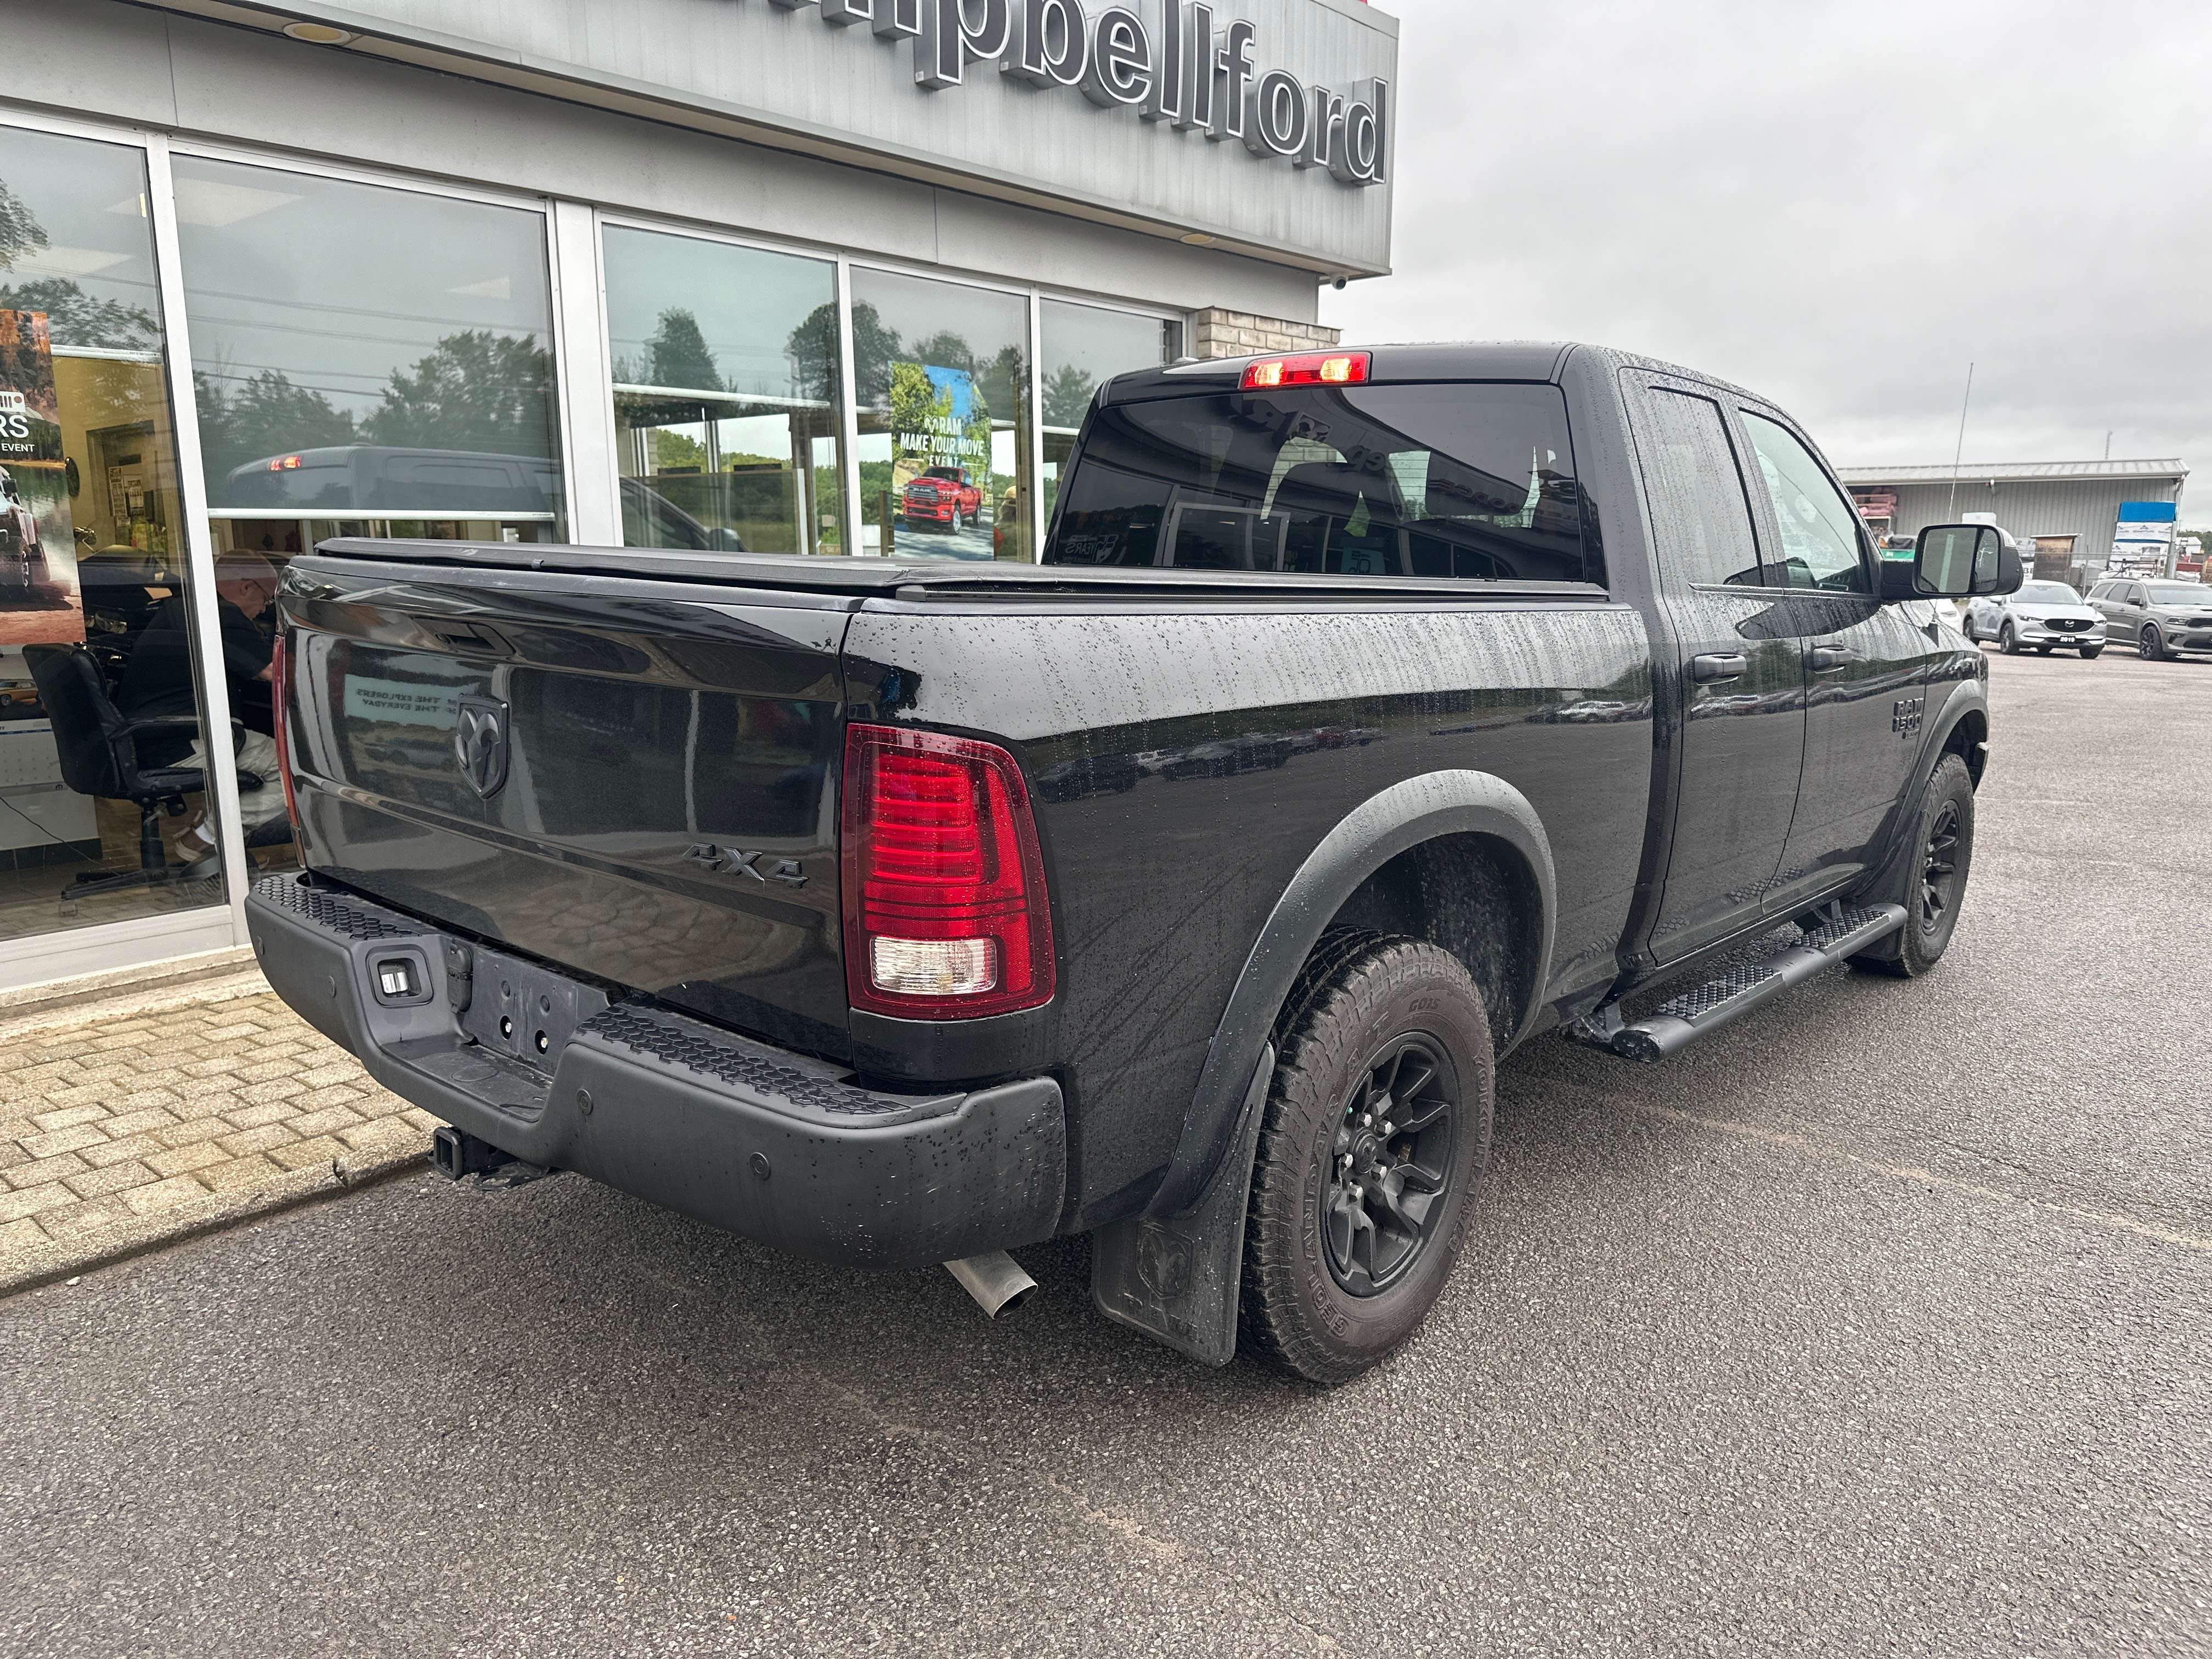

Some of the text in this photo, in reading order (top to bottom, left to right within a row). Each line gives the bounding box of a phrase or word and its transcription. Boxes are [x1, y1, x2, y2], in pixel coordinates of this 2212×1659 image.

[798, 0, 1388, 184] pbellford
[0, 414, 29, 438] RS
[939, 416, 962, 436] RAM
[2, 443, 35, 452] EVENT
[900, 432, 985, 456] MAKE YOUR MOVE
[929, 455, 959, 468] EVENT
[1894, 698, 1924, 716] RAM
[1892, 714, 1922, 732] 1500
